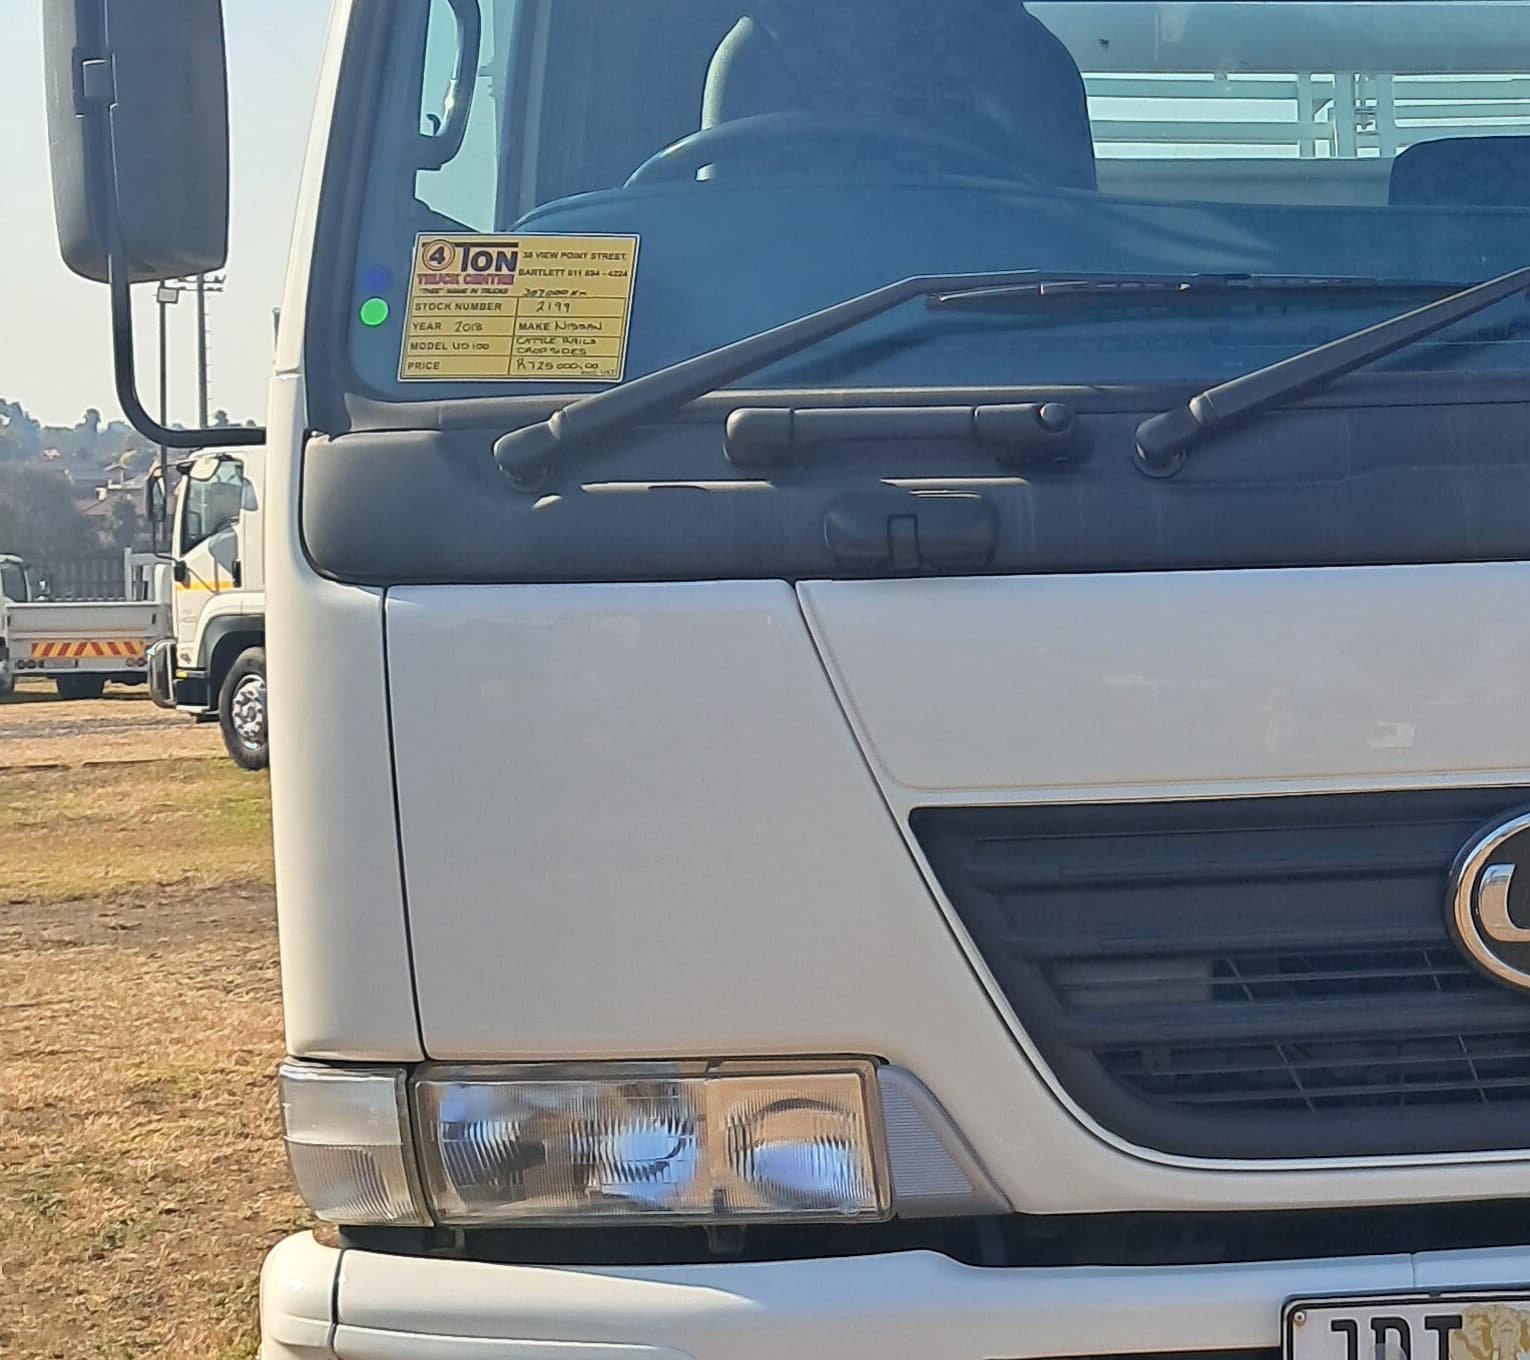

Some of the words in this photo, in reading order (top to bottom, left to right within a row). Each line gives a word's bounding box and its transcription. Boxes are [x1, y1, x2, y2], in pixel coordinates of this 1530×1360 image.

[456, 242, 518, 272] TON
[567, 269, 582, 277] 011
[417, 273, 459, 285] TRUCK
[414, 302, 452, 311] STOCK
[455, 303, 502, 311] NUMBER
[536, 301, 570, 313] 2199
[412, 322, 442, 330] YEAR
[519, 323, 550, 331] MAKE
[410, 342, 448, 350] MODEL
[407, 361, 440, 370] PRICE
